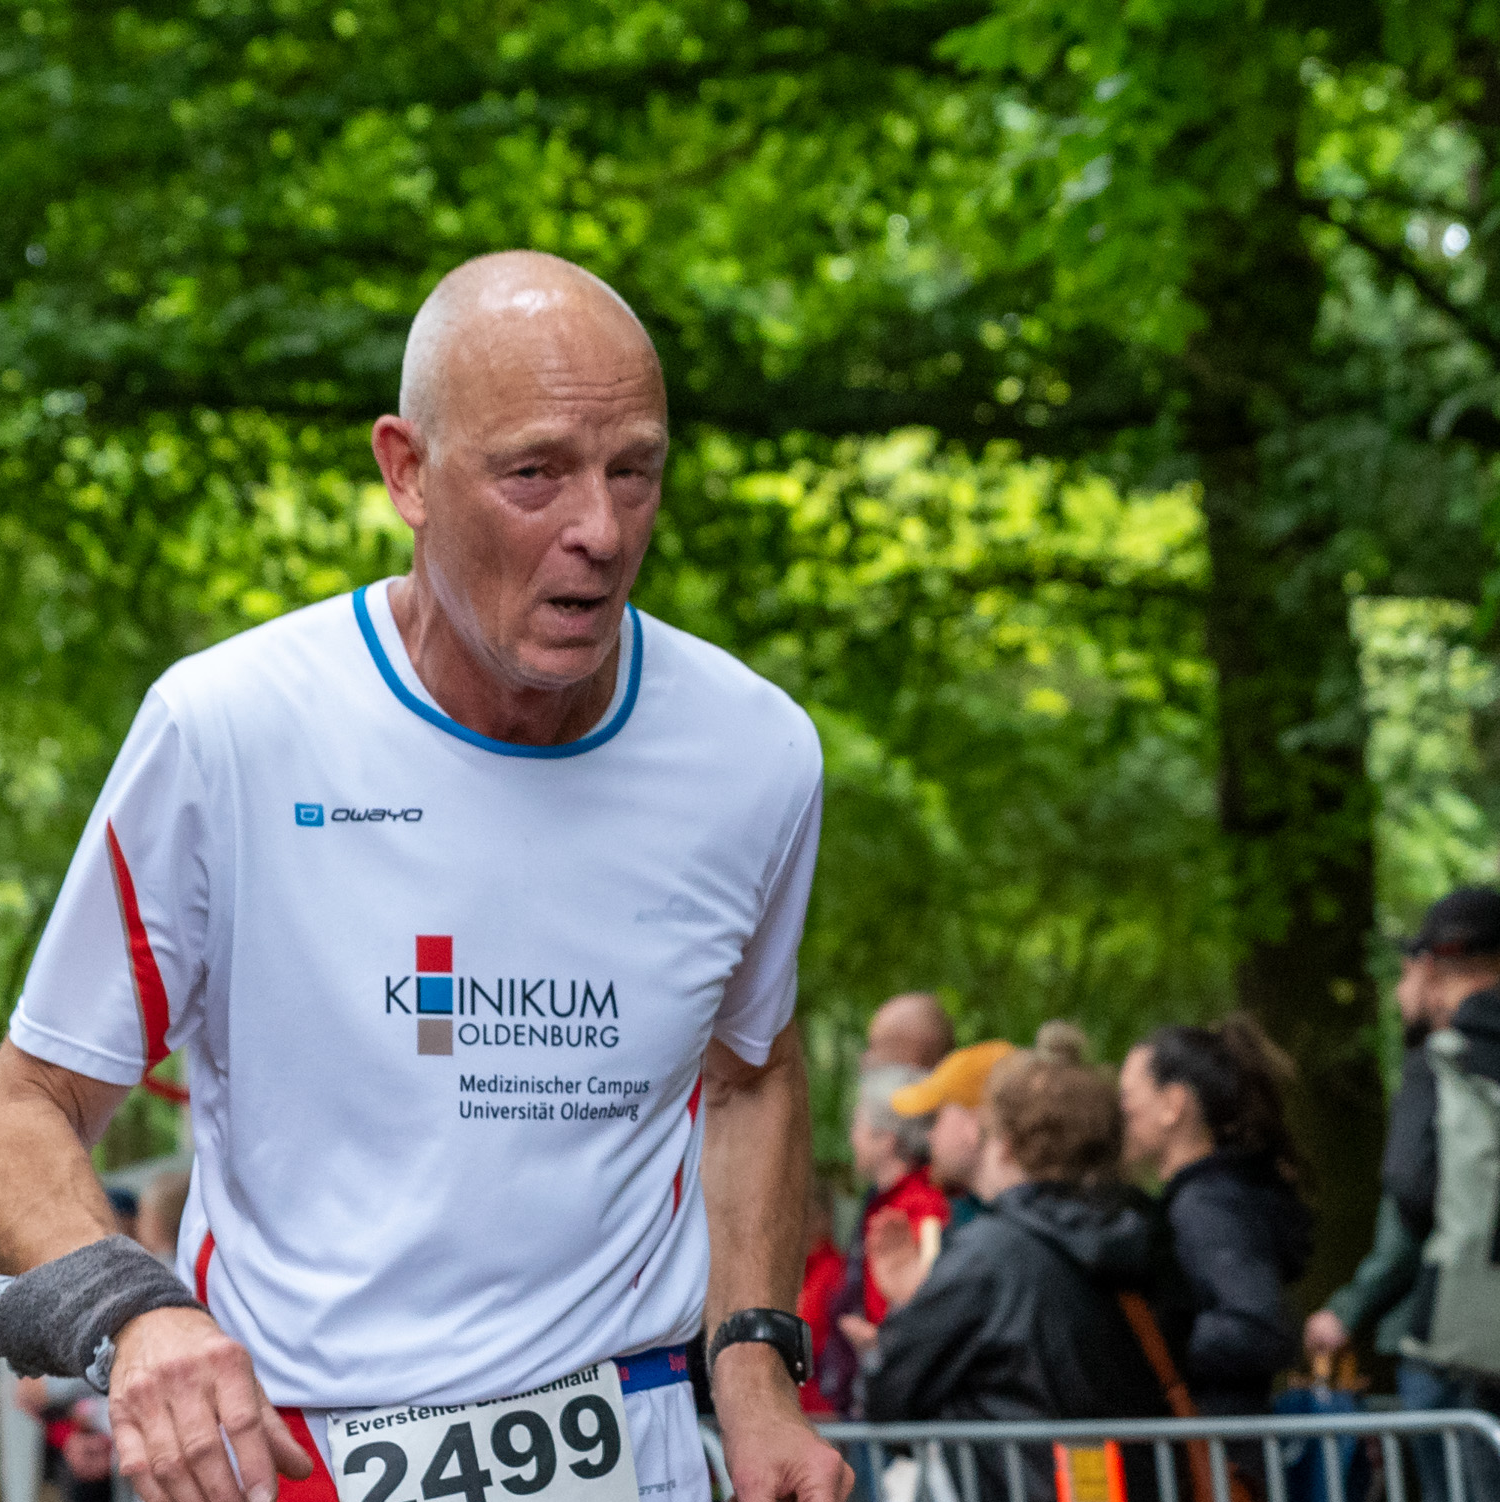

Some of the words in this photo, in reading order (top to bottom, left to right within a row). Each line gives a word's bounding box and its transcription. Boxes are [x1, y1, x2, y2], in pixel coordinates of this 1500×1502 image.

[385, 976, 619, 1018] KLINIKUM
[458, 1023, 620, 1048] OLDENBURG
[459, 1074, 582, 1095] Medizinischer
[587, 1076, 650, 1098] Campus
[459, 1101, 555, 1120] Universität
[560, 1101, 639, 1121] Oldenburg
[345, 1404, 466, 1437] Everstener
